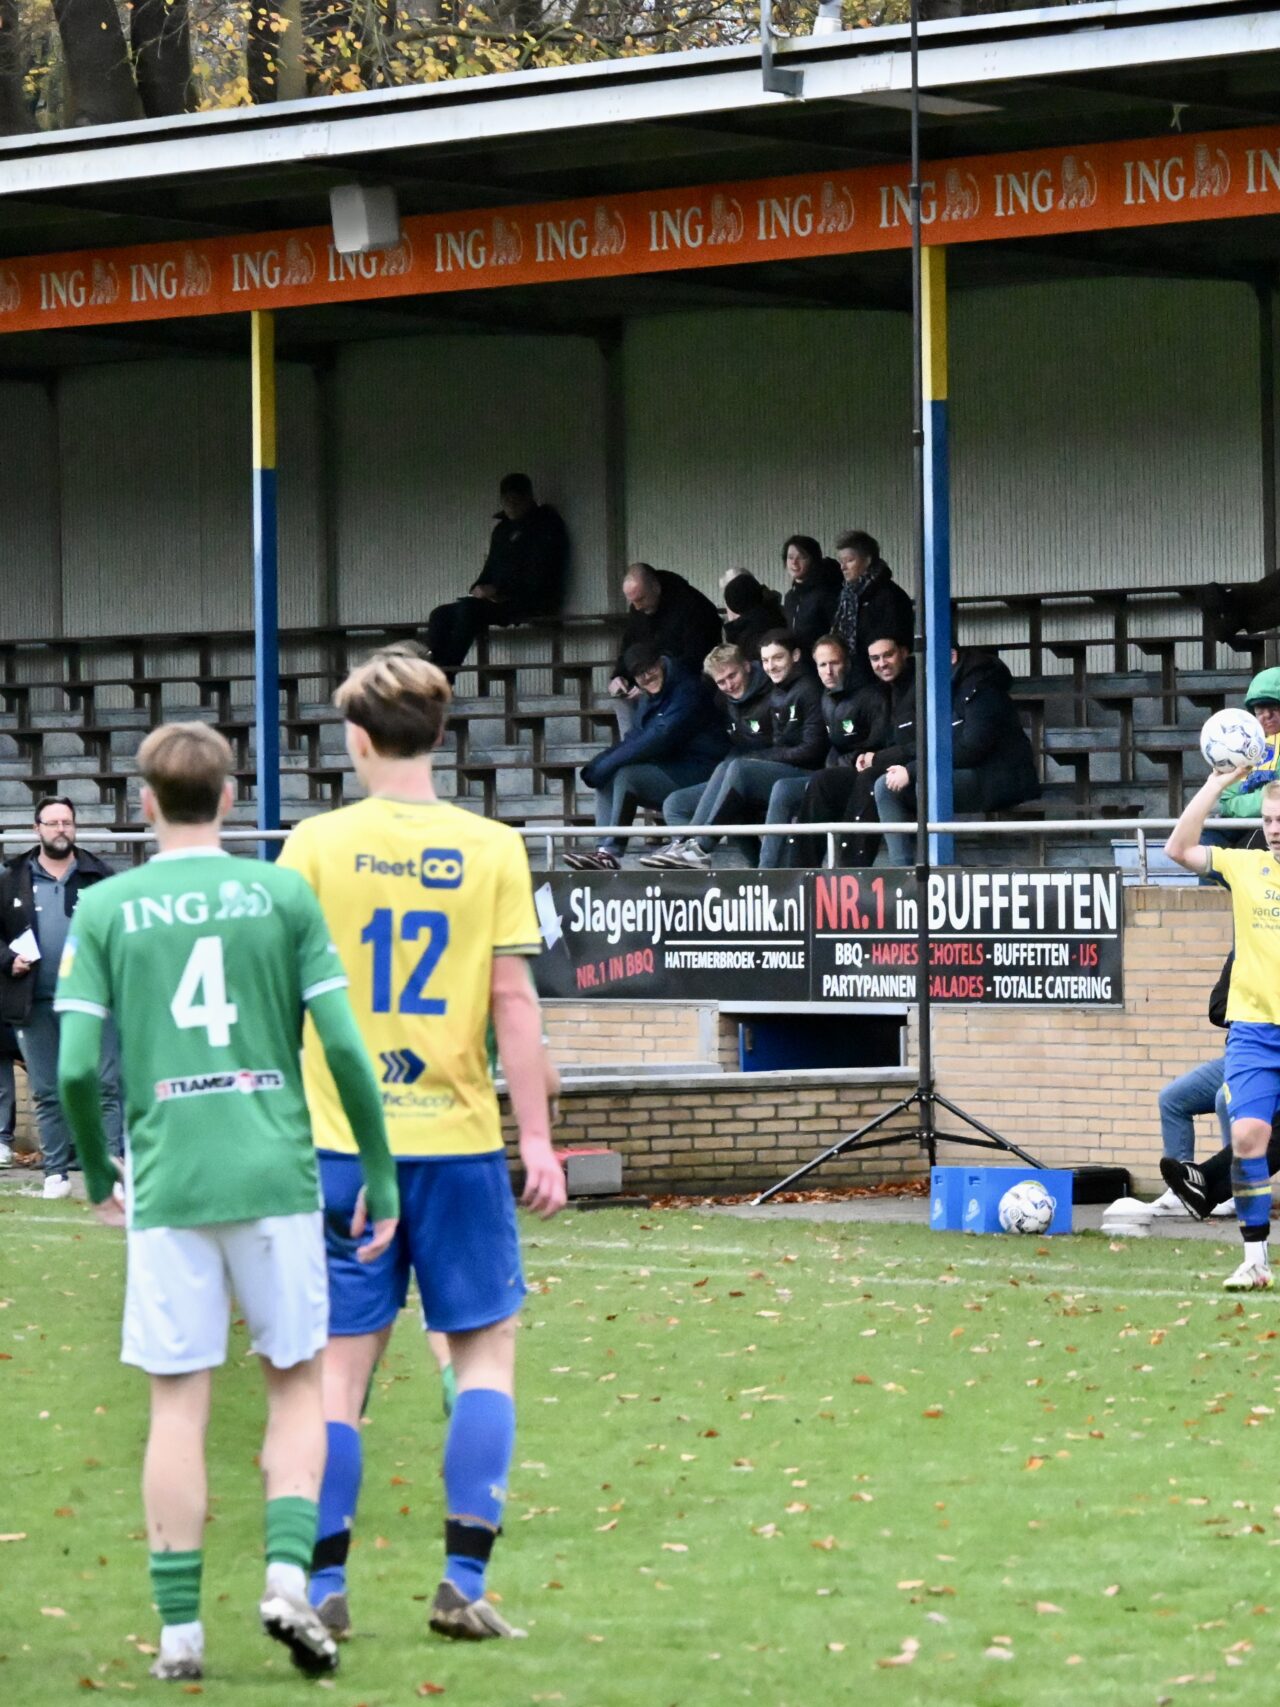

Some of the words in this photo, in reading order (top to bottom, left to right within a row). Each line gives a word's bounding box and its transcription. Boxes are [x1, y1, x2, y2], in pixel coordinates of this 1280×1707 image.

[40, 271, 86, 310] ING
[130, 262, 179, 302] ING
[232, 251, 281, 291] ING
[434, 228, 486, 272] ING
[535, 219, 588, 263] ING
[649, 207, 704, 252] ING
[757, 195, 813, 240] ING
[879, 180, 937, 228] ING
[995, 170, 1054, 216] ING
[1123, 157, 1185, 205] ING
[355, 854, 416, 877] Fleet
[121, 891, 209, 933] ING
[570, 885, 804, 944] SlagerijvanGuilik.nl
[816, 875, 885, 930] NR.1
[896, 888, 918, 930] in
[928, 873, 1117, 930] BUFFETTEN
[361, 907, 450, 1015] 12
[576, 961, 605, 990] NR.1
[609, 956, 624, 981] IN
[626, 948, 654, 977] BBQ
[665, 951, 755, 969] HATTEMERBROEK
[762, 951, 805, 969] ZWOLLE
[835, 943, 862, 968] BBQ
[993, 943, 1069, 966] BUFFETTEN
[1080, 943, 1098, 967] IJS
[170, 936, 238, 1047] 4
[822, 974, 916, 998] PARTYPANNEN
[993, 975, 1042, 998] TOTALE
[1045, 976, 1112, 999] CATERING
